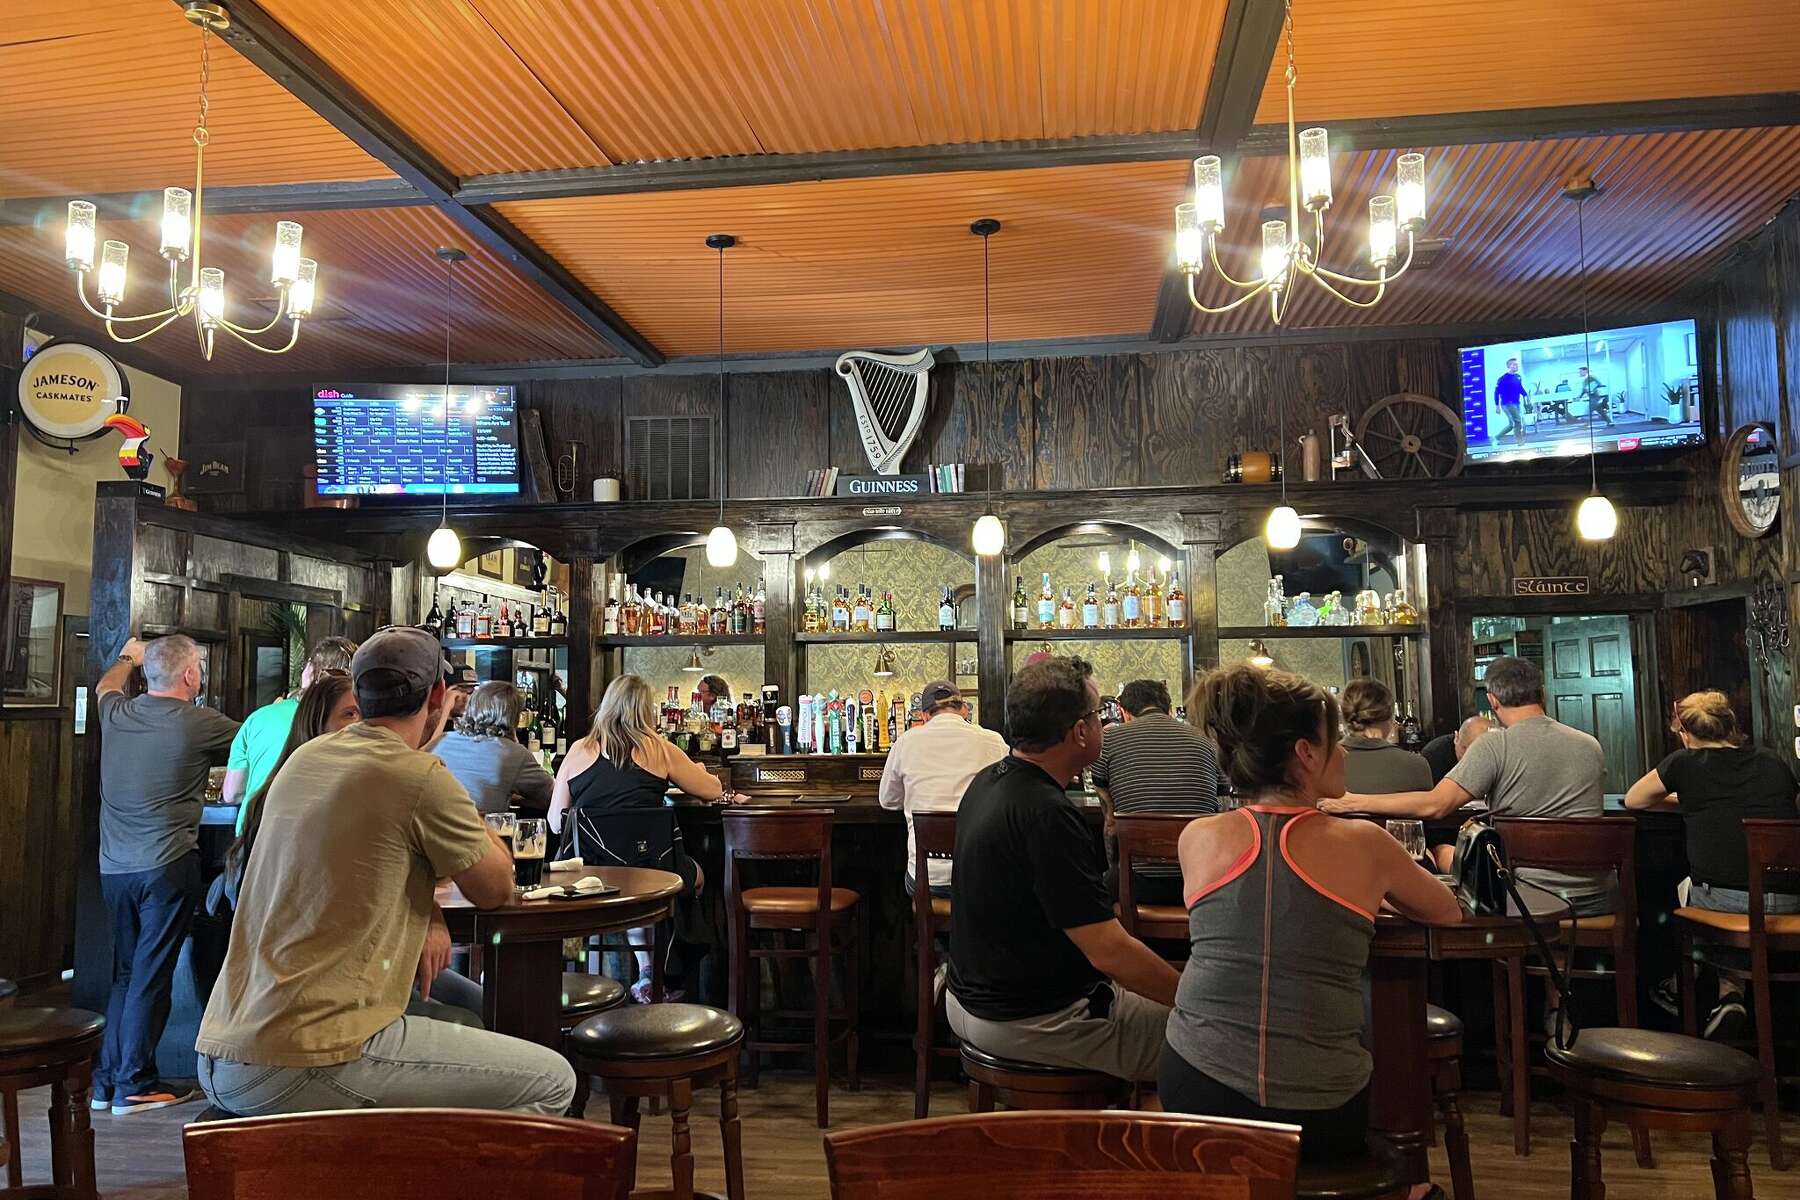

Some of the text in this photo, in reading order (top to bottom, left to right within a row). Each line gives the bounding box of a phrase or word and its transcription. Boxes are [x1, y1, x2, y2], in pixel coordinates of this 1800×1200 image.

[33, 374, 97, 391] JAMESON
[36, 392, 93, 402] CASKMATES
[317, 389, 340, 399] dish
[865, 434, 882, 460] 1759
[849, 479, 918, 494] GUINNESS
[1517, 579, 1585, 593] Sláinte
